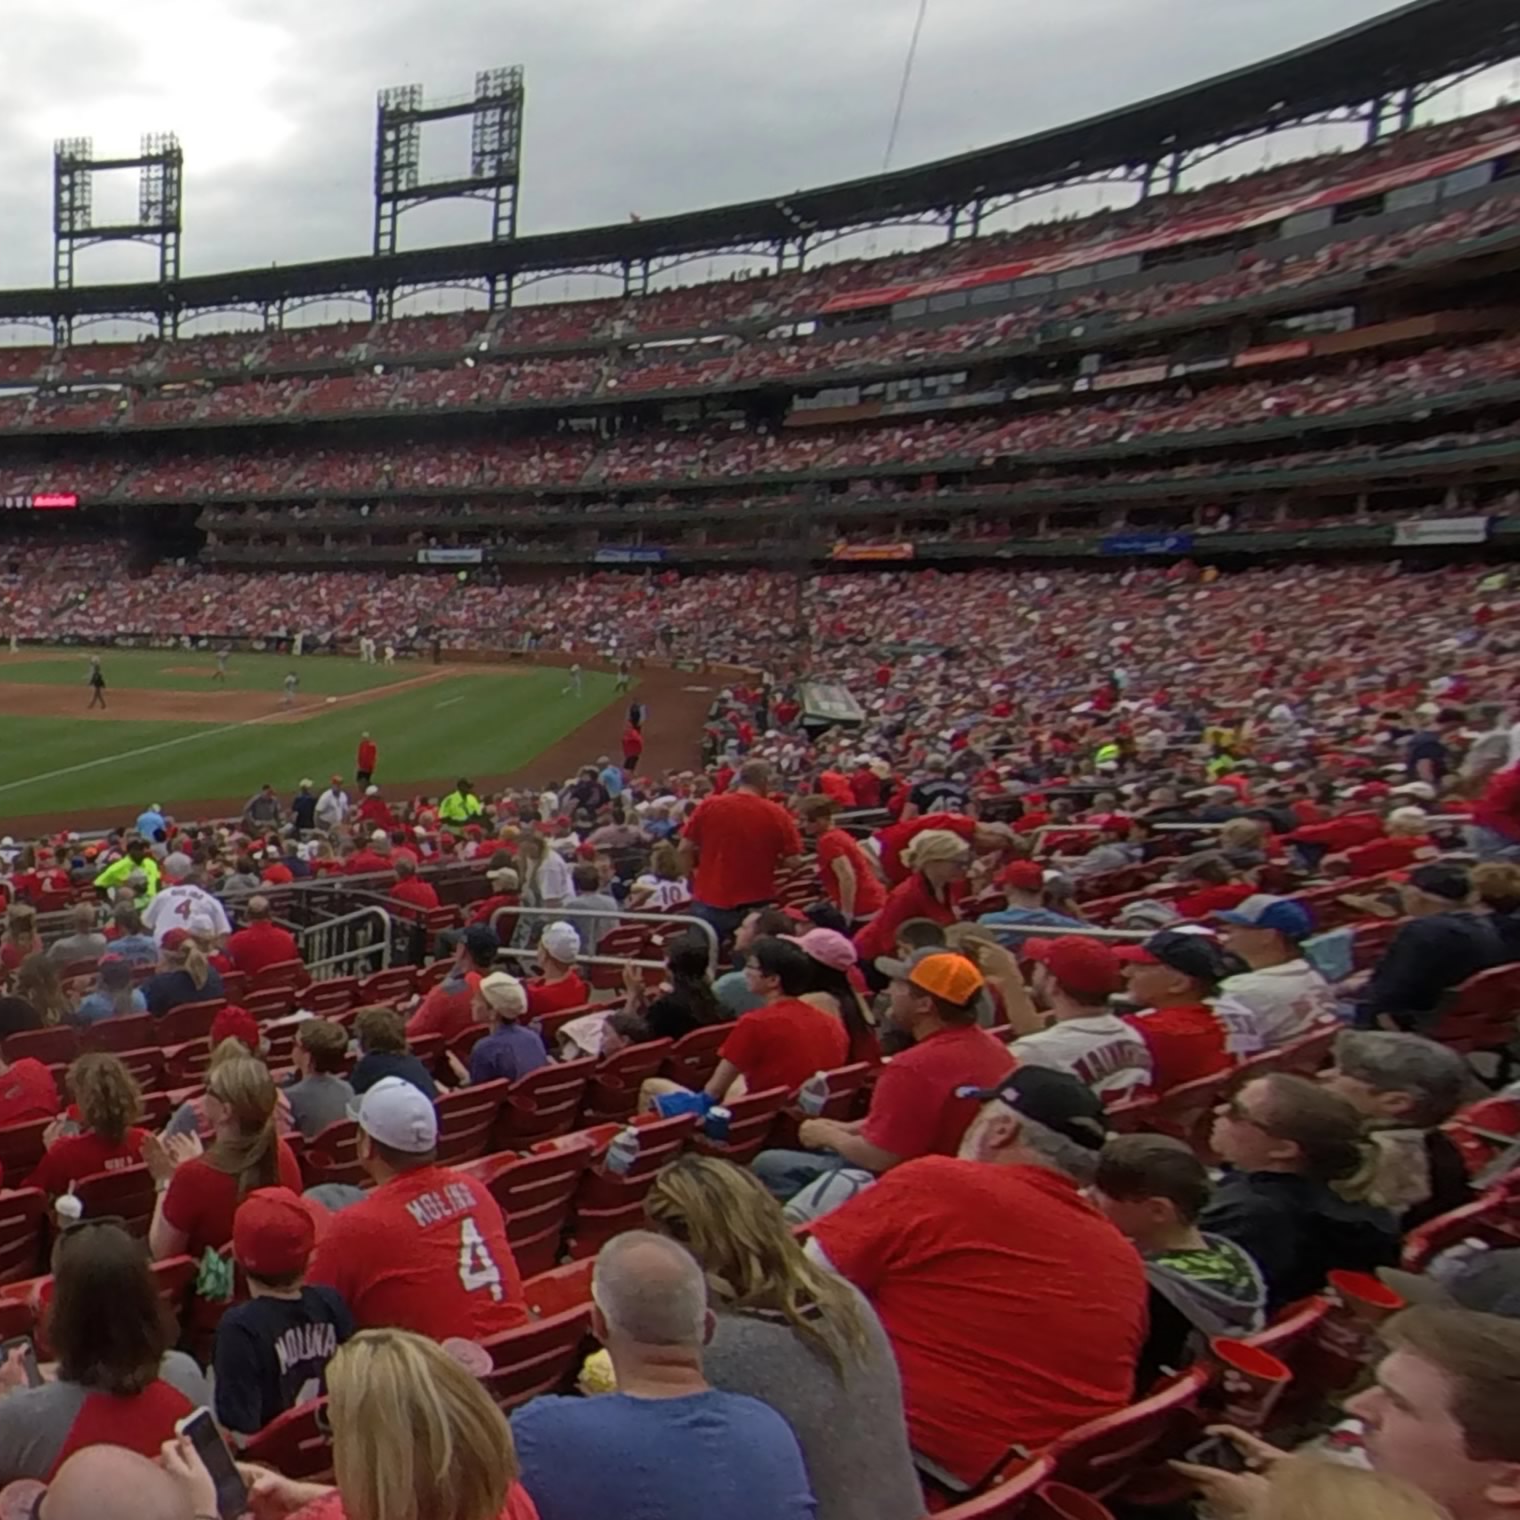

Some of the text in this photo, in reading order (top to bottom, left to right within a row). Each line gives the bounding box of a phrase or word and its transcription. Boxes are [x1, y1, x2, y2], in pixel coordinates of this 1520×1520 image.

[174, 899, 192, 920] 4
[661, 886, 682, 905] 10
[405, 1183, 477, 1227] MOLINA
[459, 1216, 502, 1302] 4
[274, 1322, 337, 1375] MOLINA
